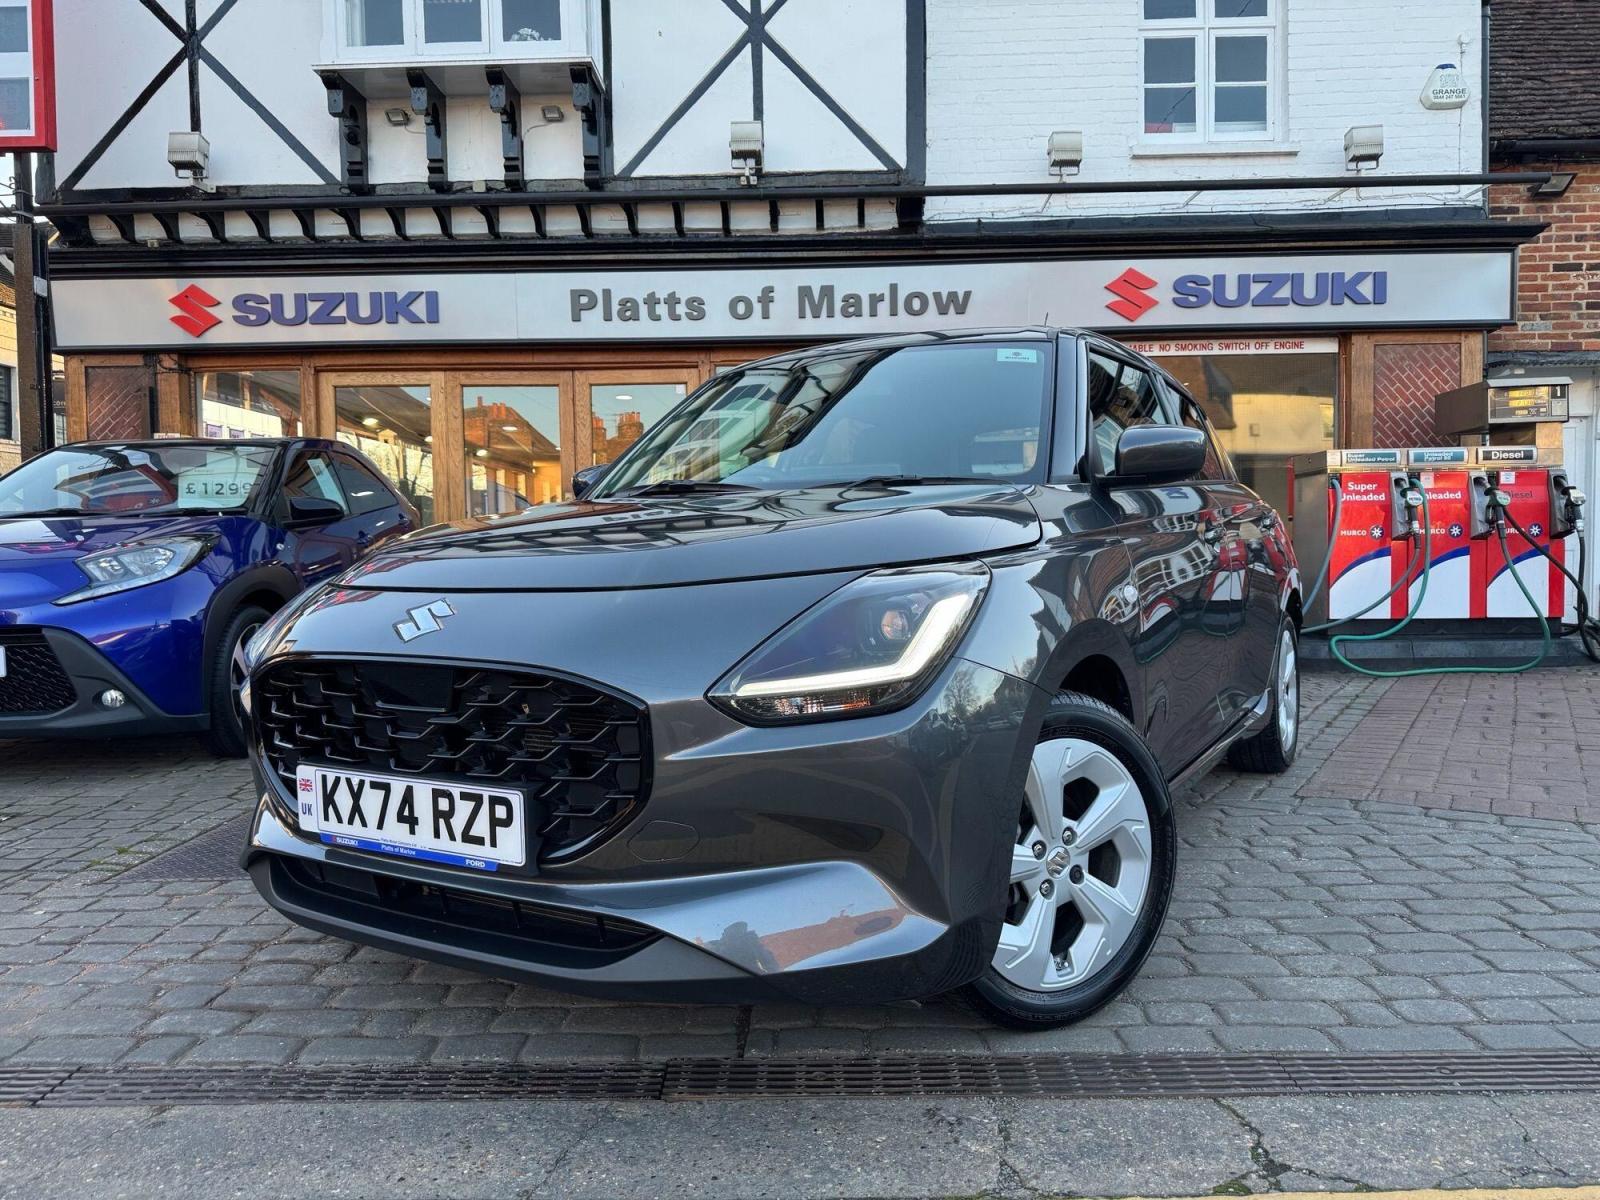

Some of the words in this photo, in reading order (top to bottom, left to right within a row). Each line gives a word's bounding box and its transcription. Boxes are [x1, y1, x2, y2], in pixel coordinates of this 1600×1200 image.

[1432, 88, 1467, 96] GRANGE
[1172, 271, 1387, 308] SUZUKI
[570, 288, 706, 322] Platts
[728, 286, 775, 320] of
[798, 283, 972, 319] Marlow
[232, 291, 439, 326] SUZUKI
[1129, 343, 1154, 353] ABLE
[1159, 343, 1171, 352] NO
[1174, 342, 1213, 352] SMOKING
[1218, 341, 1250, 351] SWITCH
[1254, 341, 1270, 350] OFF
[1274, 340, 1305, 350] ENGINE
[1556, 386, 1561, 397] 1
[1491, 450, 1524, 459] Diesel
[1348, 482, 1378, 492] Super
[1425, 491, 1462, 500] nleaded
[301, 802, 313, 816] UK
[320, 774, 419, 836] KX74
[431, 787, 514, 849] RZP
[336, 835, 359, 846] SUZUKI
[381, 844, 394, 852] Platts
[399, 847, 416, 855] Marlow
[465, 859, 486, 868] FORD
